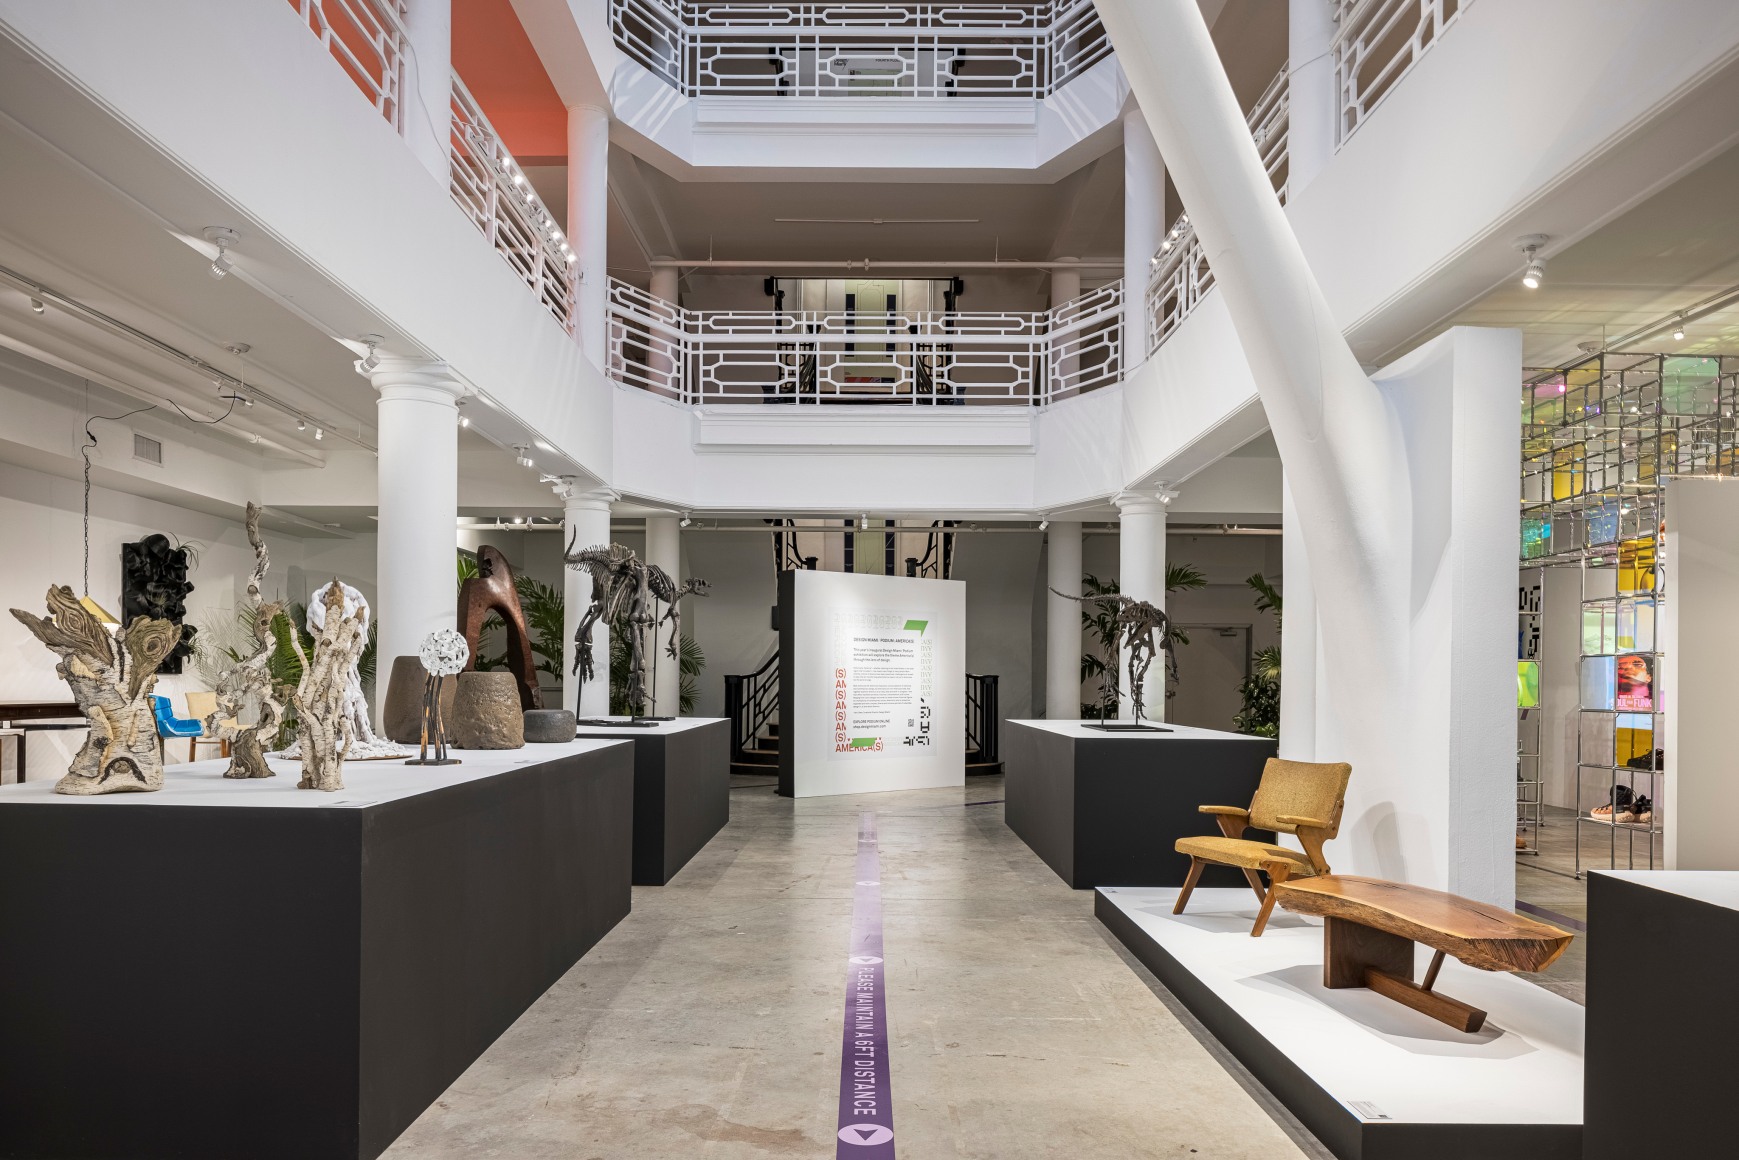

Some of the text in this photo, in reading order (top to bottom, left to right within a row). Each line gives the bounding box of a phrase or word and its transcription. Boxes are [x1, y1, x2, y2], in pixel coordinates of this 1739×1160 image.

[836, 668, 846, 678] (S)
[836, 690, 846, 700] (S)
[836, 711, 846, 721] (S)
[836, 732, 846, 742] (S)
[858, 968, 874, 990] PLEASE
[856, 992, 874, 1029] MAINTAIN
[855, 1040, 874, 1057] 6FT
[854, 1061, 876, 1115] DISTANCE
